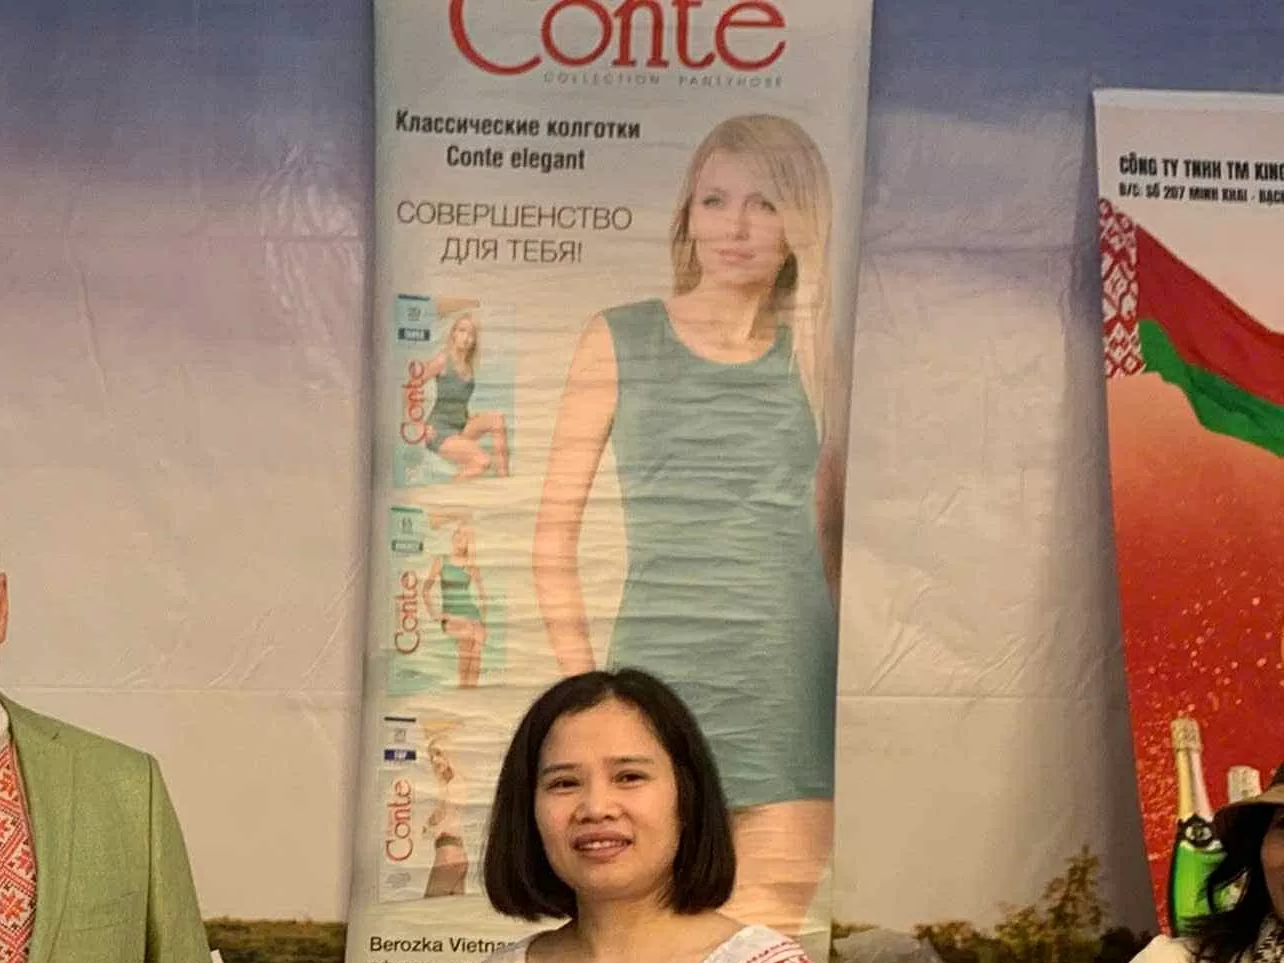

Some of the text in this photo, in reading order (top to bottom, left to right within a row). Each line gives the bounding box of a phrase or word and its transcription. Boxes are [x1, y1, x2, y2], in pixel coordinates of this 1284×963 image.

[543, 73, 661, 86] COLLECTION
[396, 110, 641, 140] Классические колготки
[446, 144, 586, 174] Conte elegant
[1119, 151, 1157, 177] CÔNG
[1162, 158, 1179, 178] TY
[1183, 159, 1222, 179] TNHH
[1227, 161, 1249, 180] TM
[396, 200, 633, 231] СОВЕРШЕНСТВО
[440, 238, 583, 264] ДЛЯ ТЕБЯ!
[400, 360, 426, 445] Conte
[394, 570, 421, 655] Conte
[385, 779, 414, 862] Conte
[370, 936, 443, 953] Berozka
